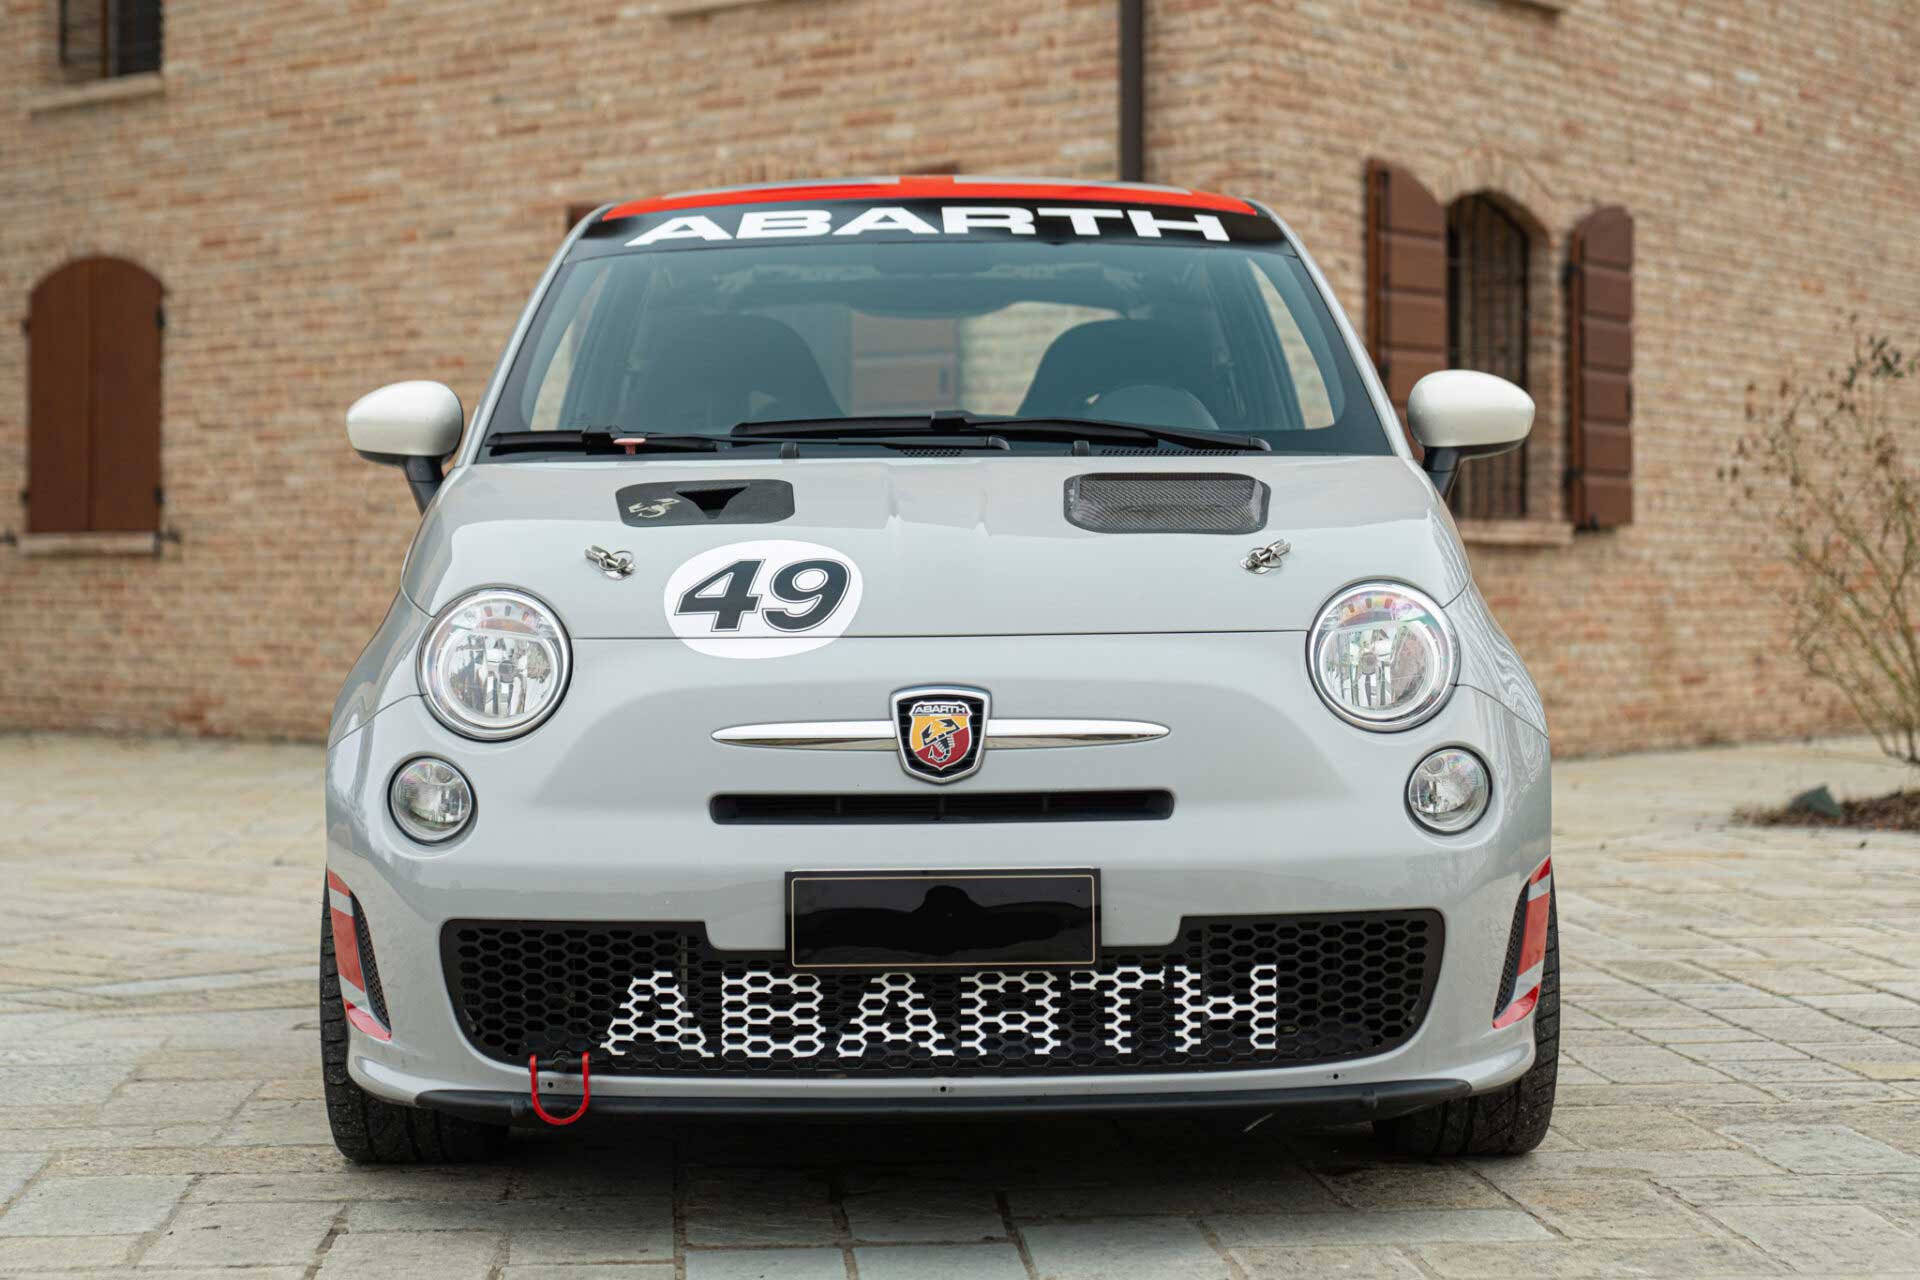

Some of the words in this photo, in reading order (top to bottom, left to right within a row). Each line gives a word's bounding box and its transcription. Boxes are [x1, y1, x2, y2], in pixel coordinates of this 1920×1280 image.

[624, 206, 1230, 247] ABARTH
[674, 558, 851, 632] 49
[915, 705, 965, 713] ABARTH
[600, 963, 1278, 1058] ABARTH
